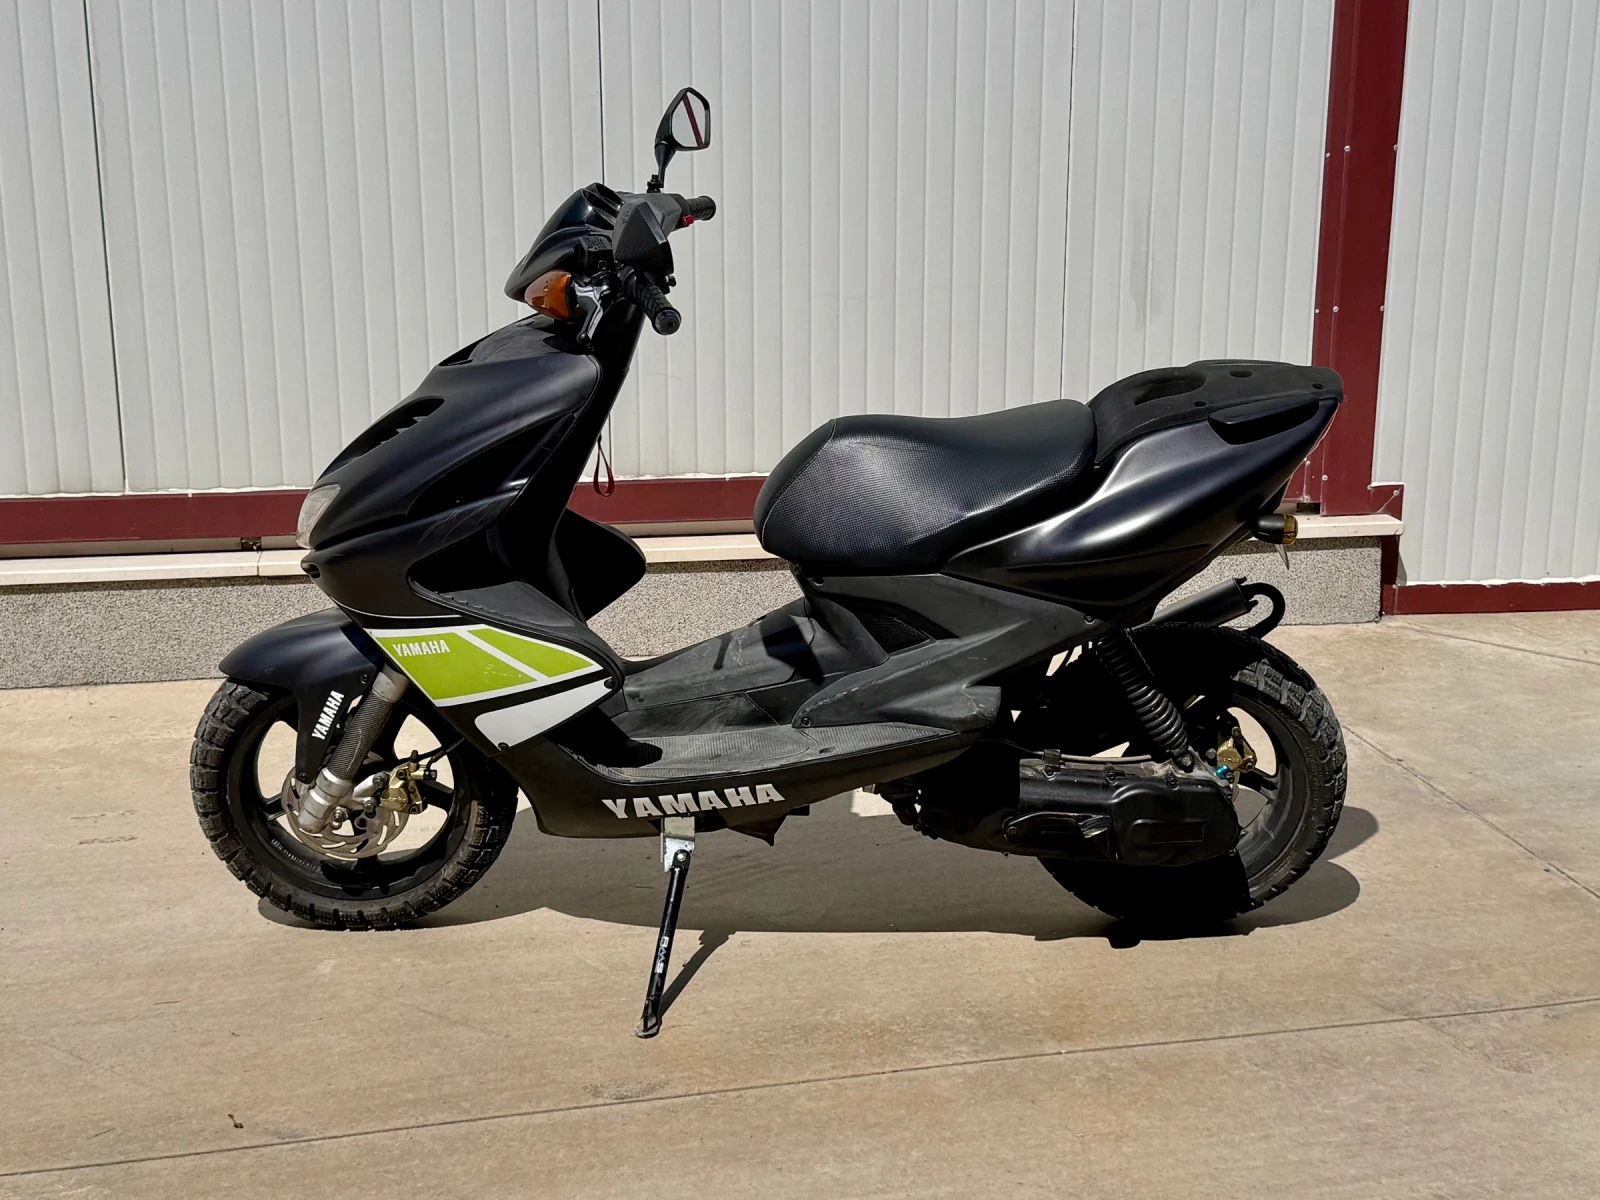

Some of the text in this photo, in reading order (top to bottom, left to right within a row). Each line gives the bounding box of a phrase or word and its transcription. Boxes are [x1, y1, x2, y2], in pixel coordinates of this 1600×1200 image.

[392, 639, 451, 657] YAMAHA
[311, 690, 345, 740] YAMAHA
[601, 783, 786, 819] YAMAHA
